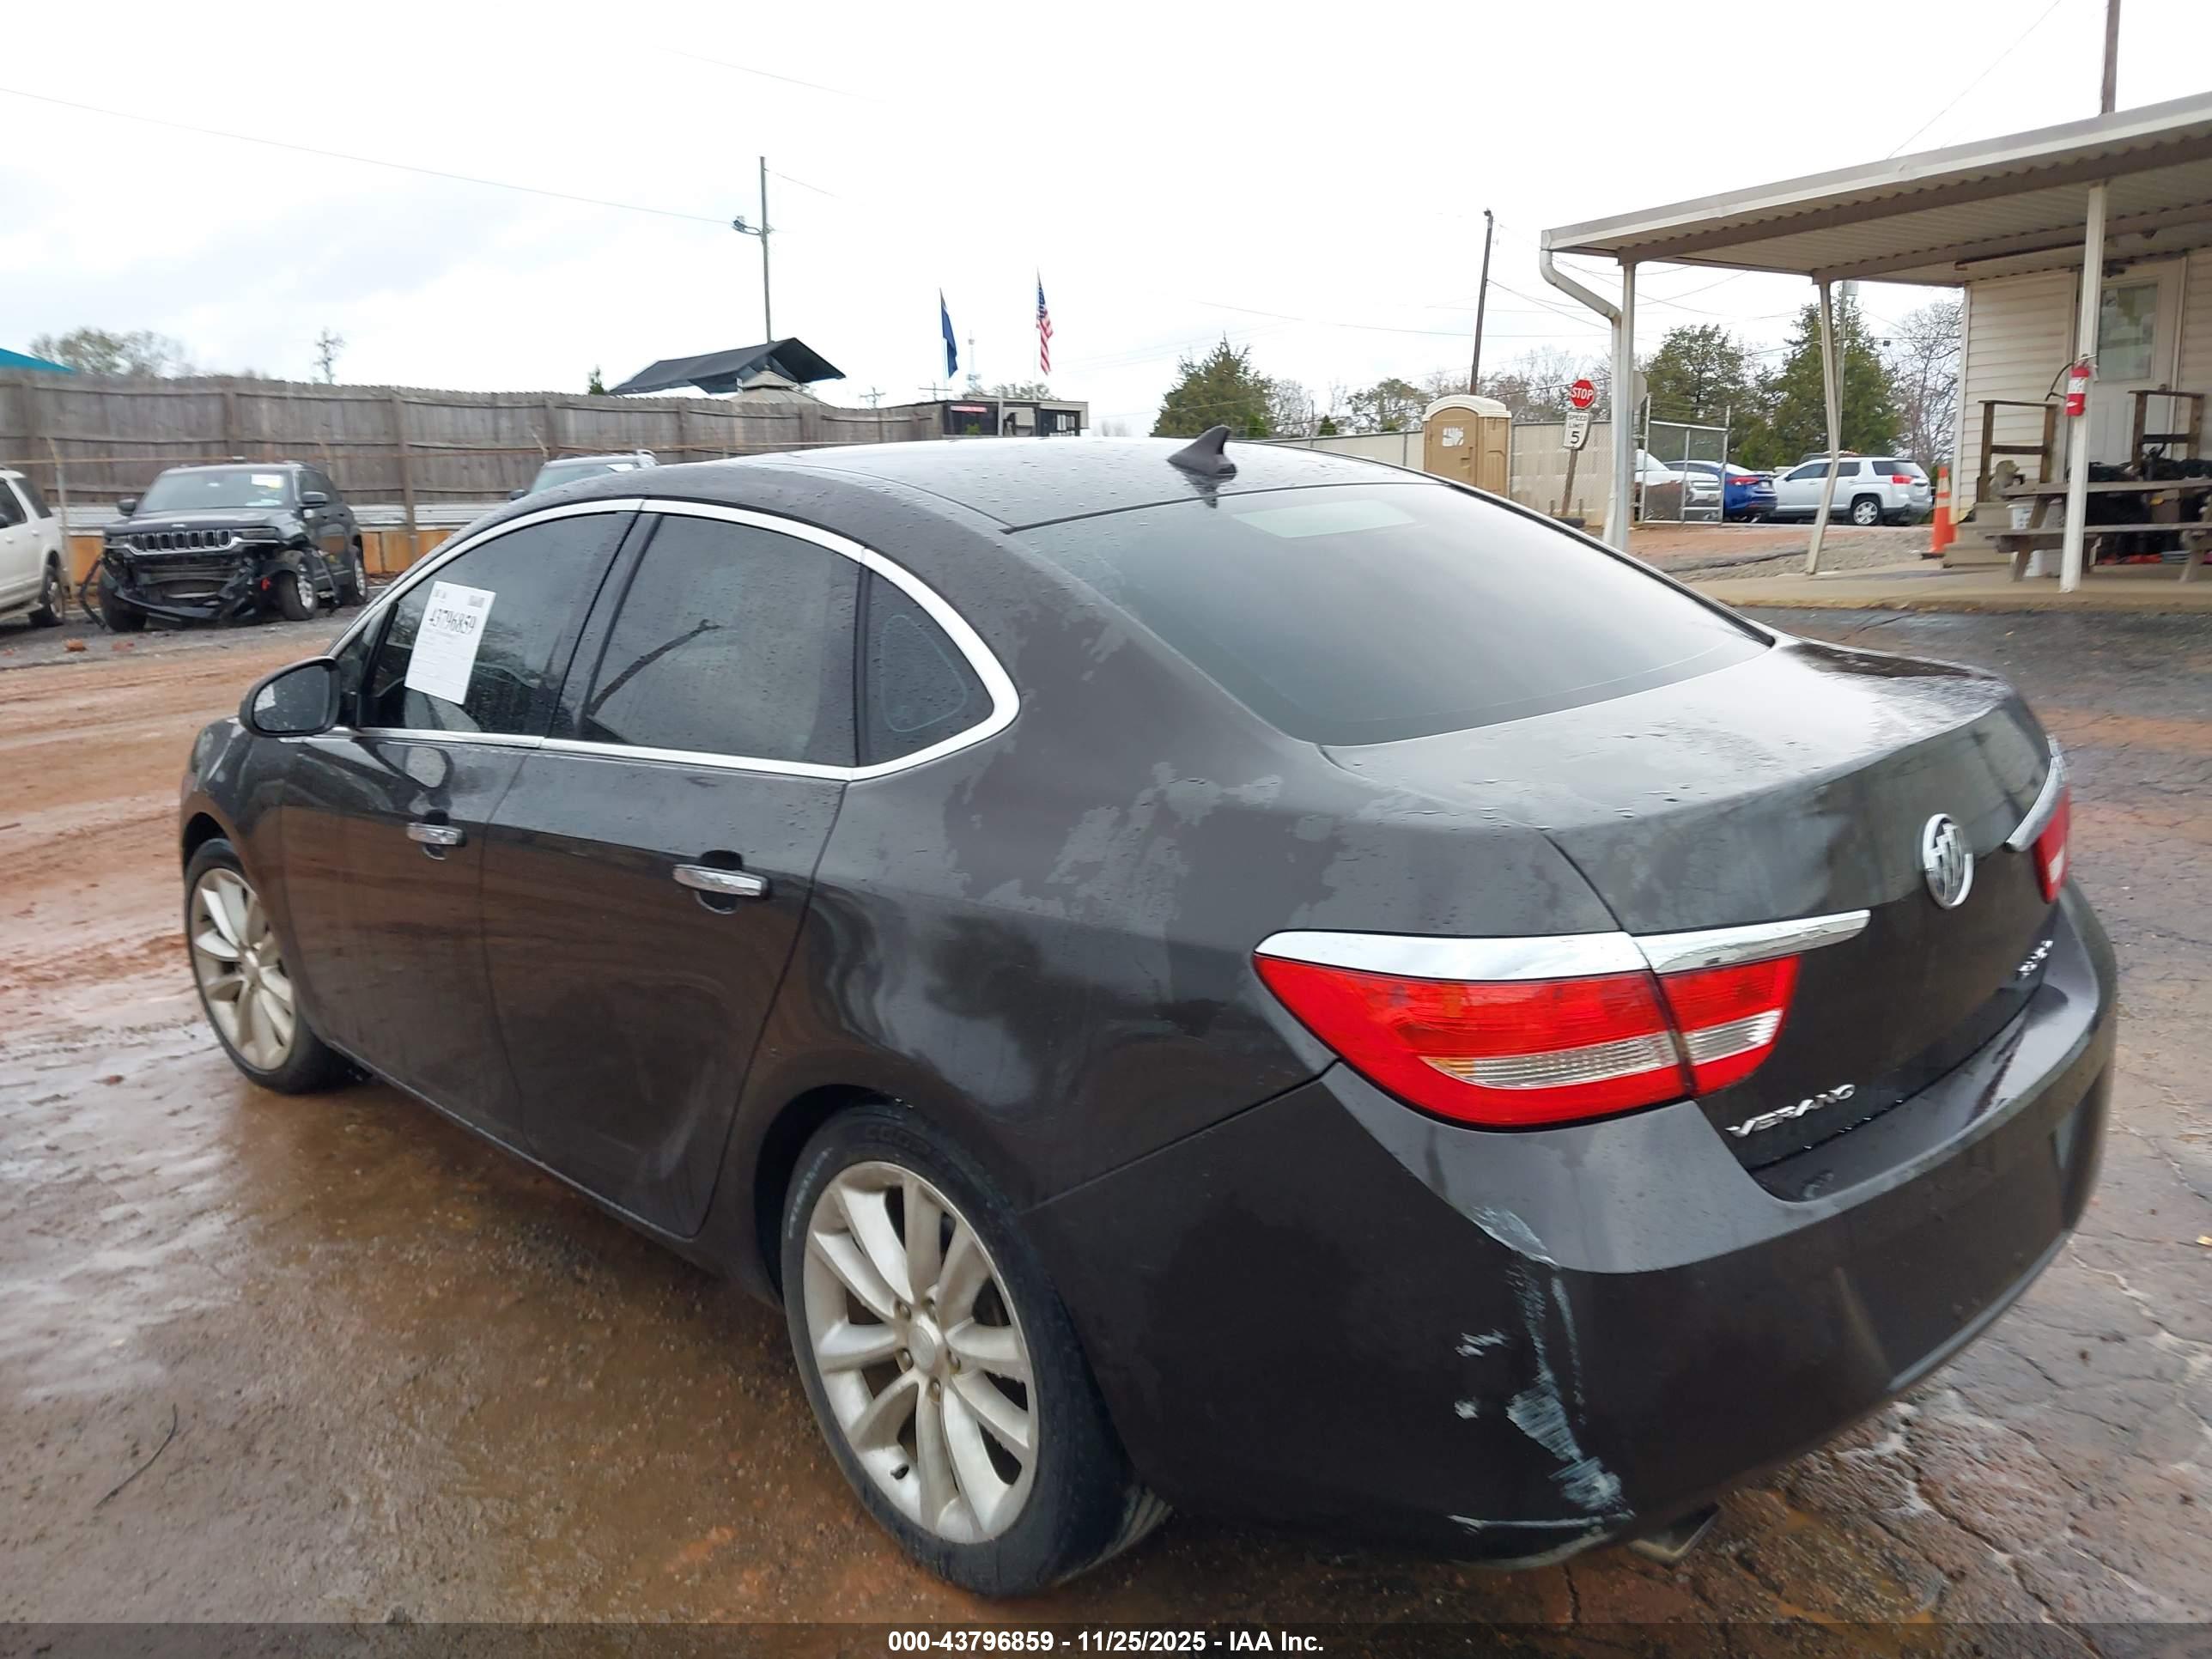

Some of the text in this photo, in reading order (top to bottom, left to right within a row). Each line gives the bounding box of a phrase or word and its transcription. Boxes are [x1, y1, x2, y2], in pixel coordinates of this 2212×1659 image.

[1571, 386, 1594, 400] STOP
[1570, 430, 1580, 444] 5
[1724, 1084, 1856, 1138] VERANO
